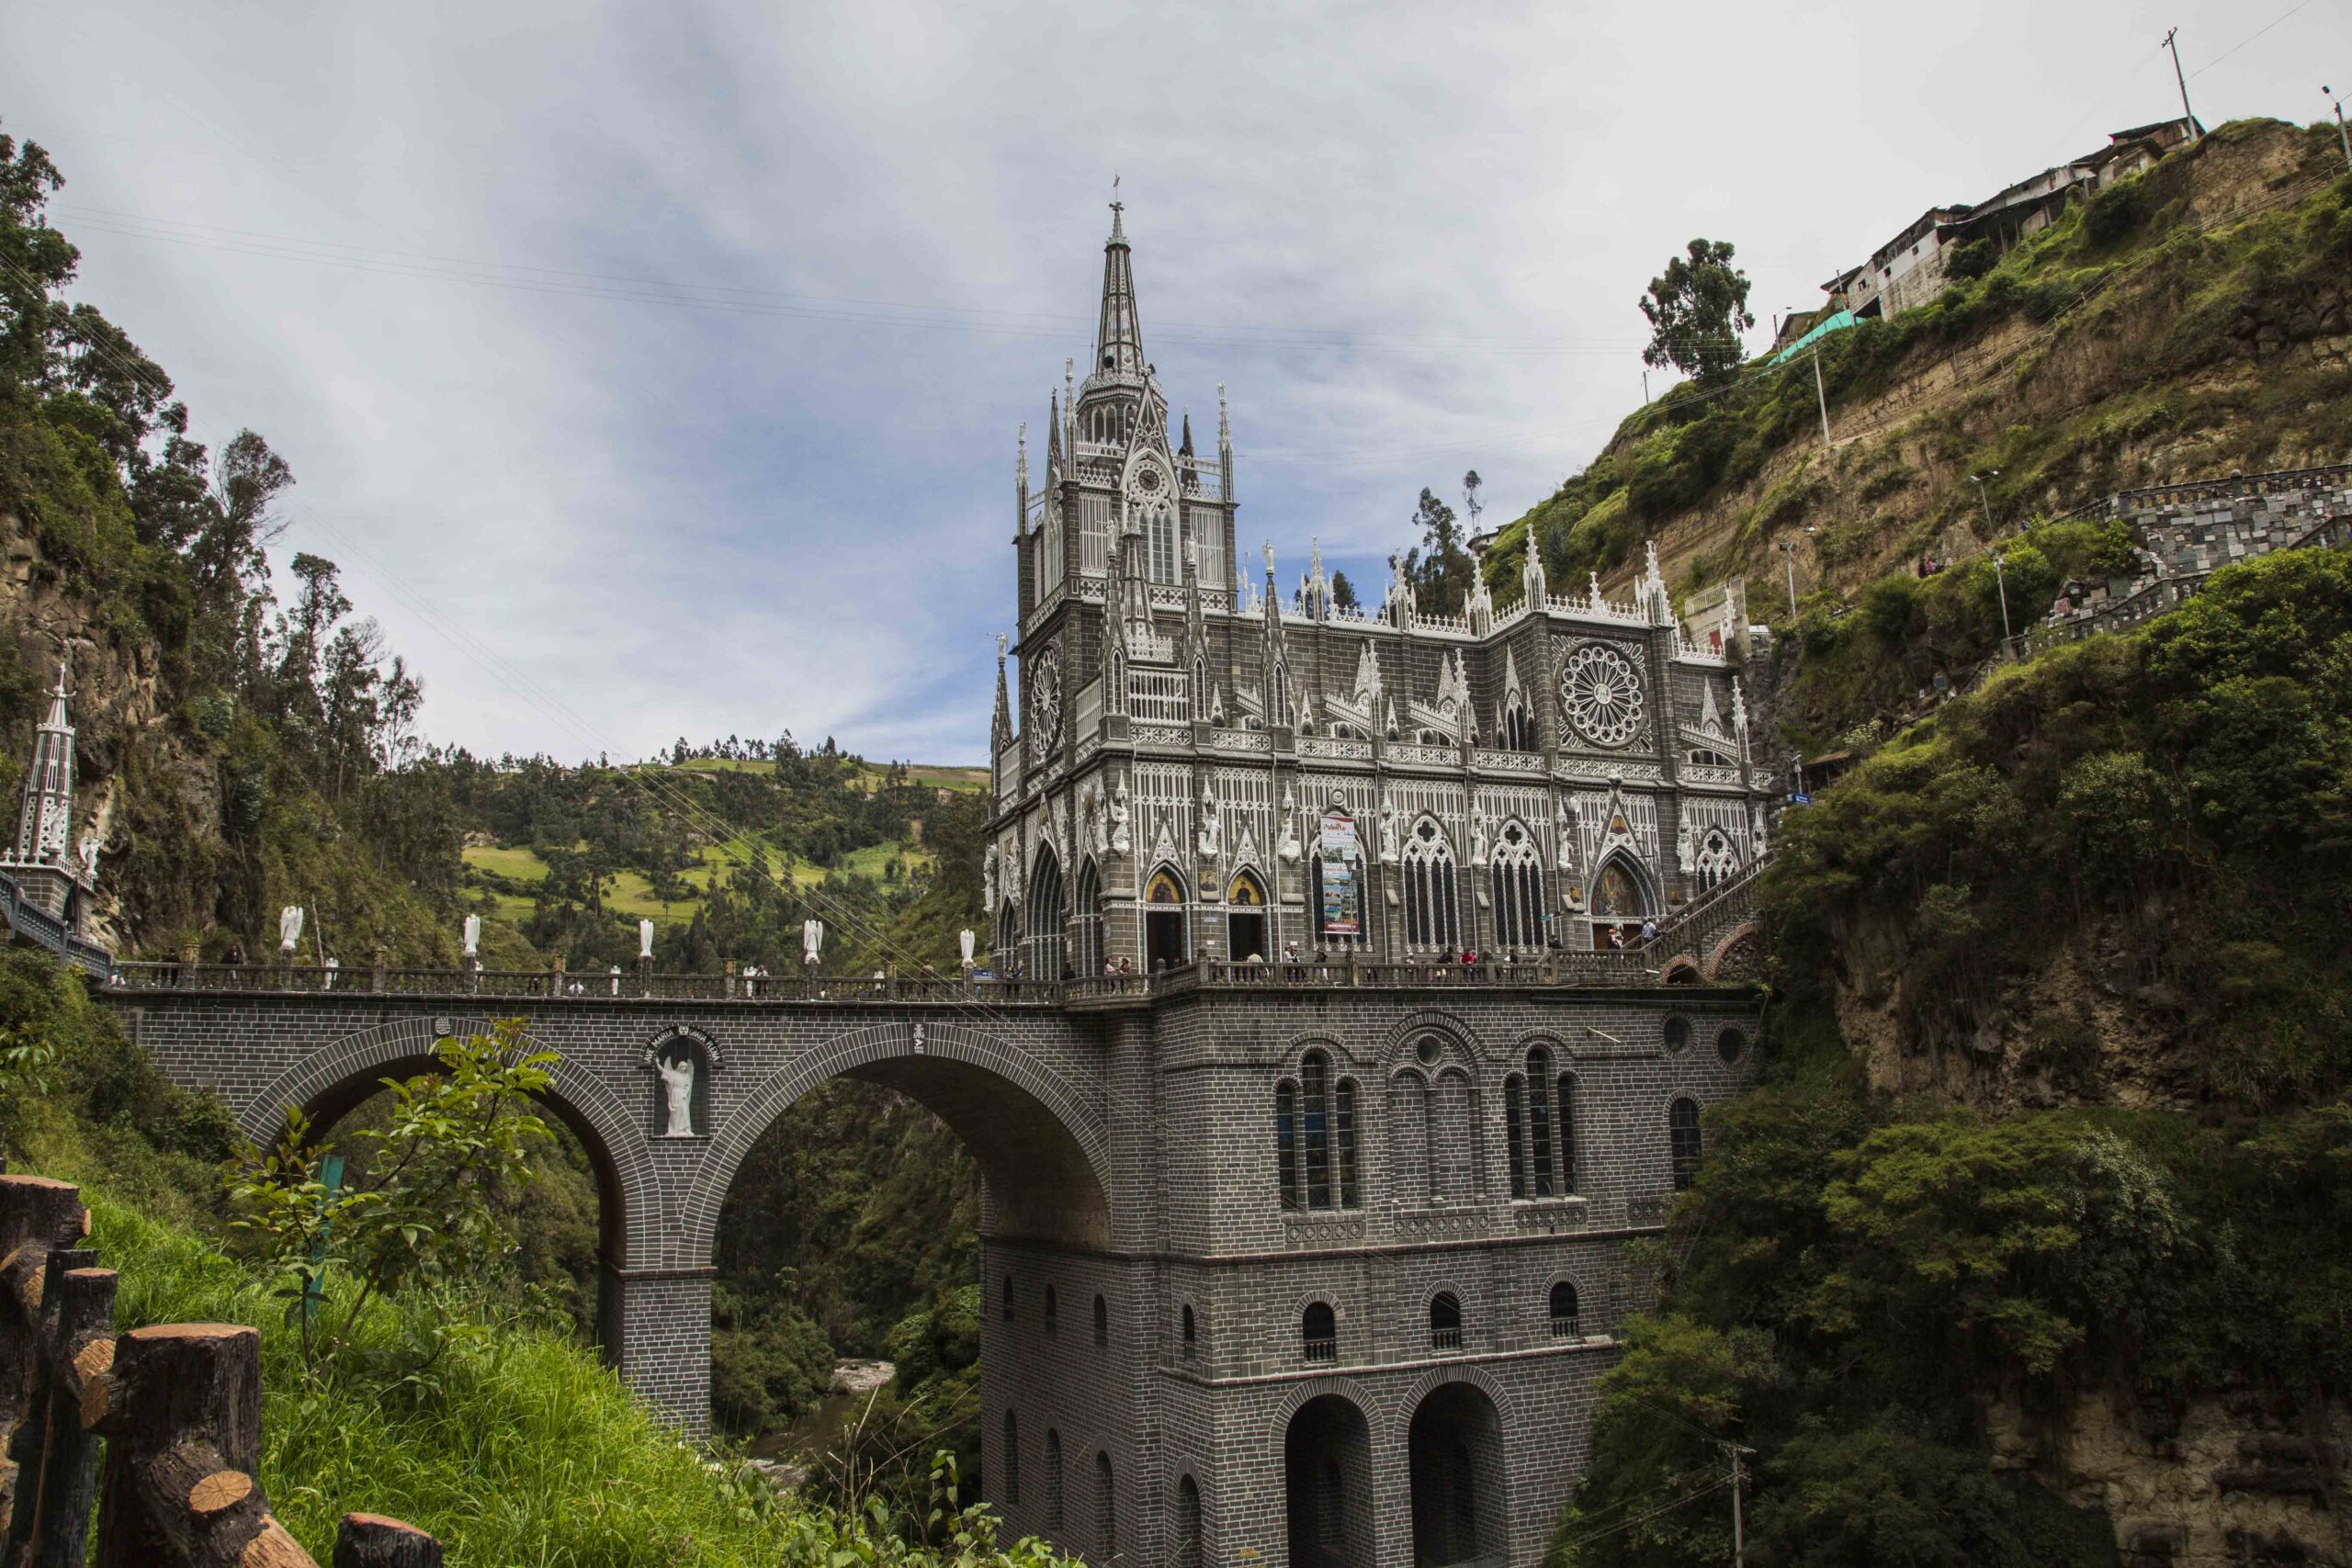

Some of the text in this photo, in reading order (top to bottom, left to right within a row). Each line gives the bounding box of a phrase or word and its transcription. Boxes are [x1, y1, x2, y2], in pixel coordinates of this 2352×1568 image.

[644, 1049, 654, 1061] AVE
[651, 1030, 674, 1047] MARIA
[707, 1041, 720, 1061] PLENA
